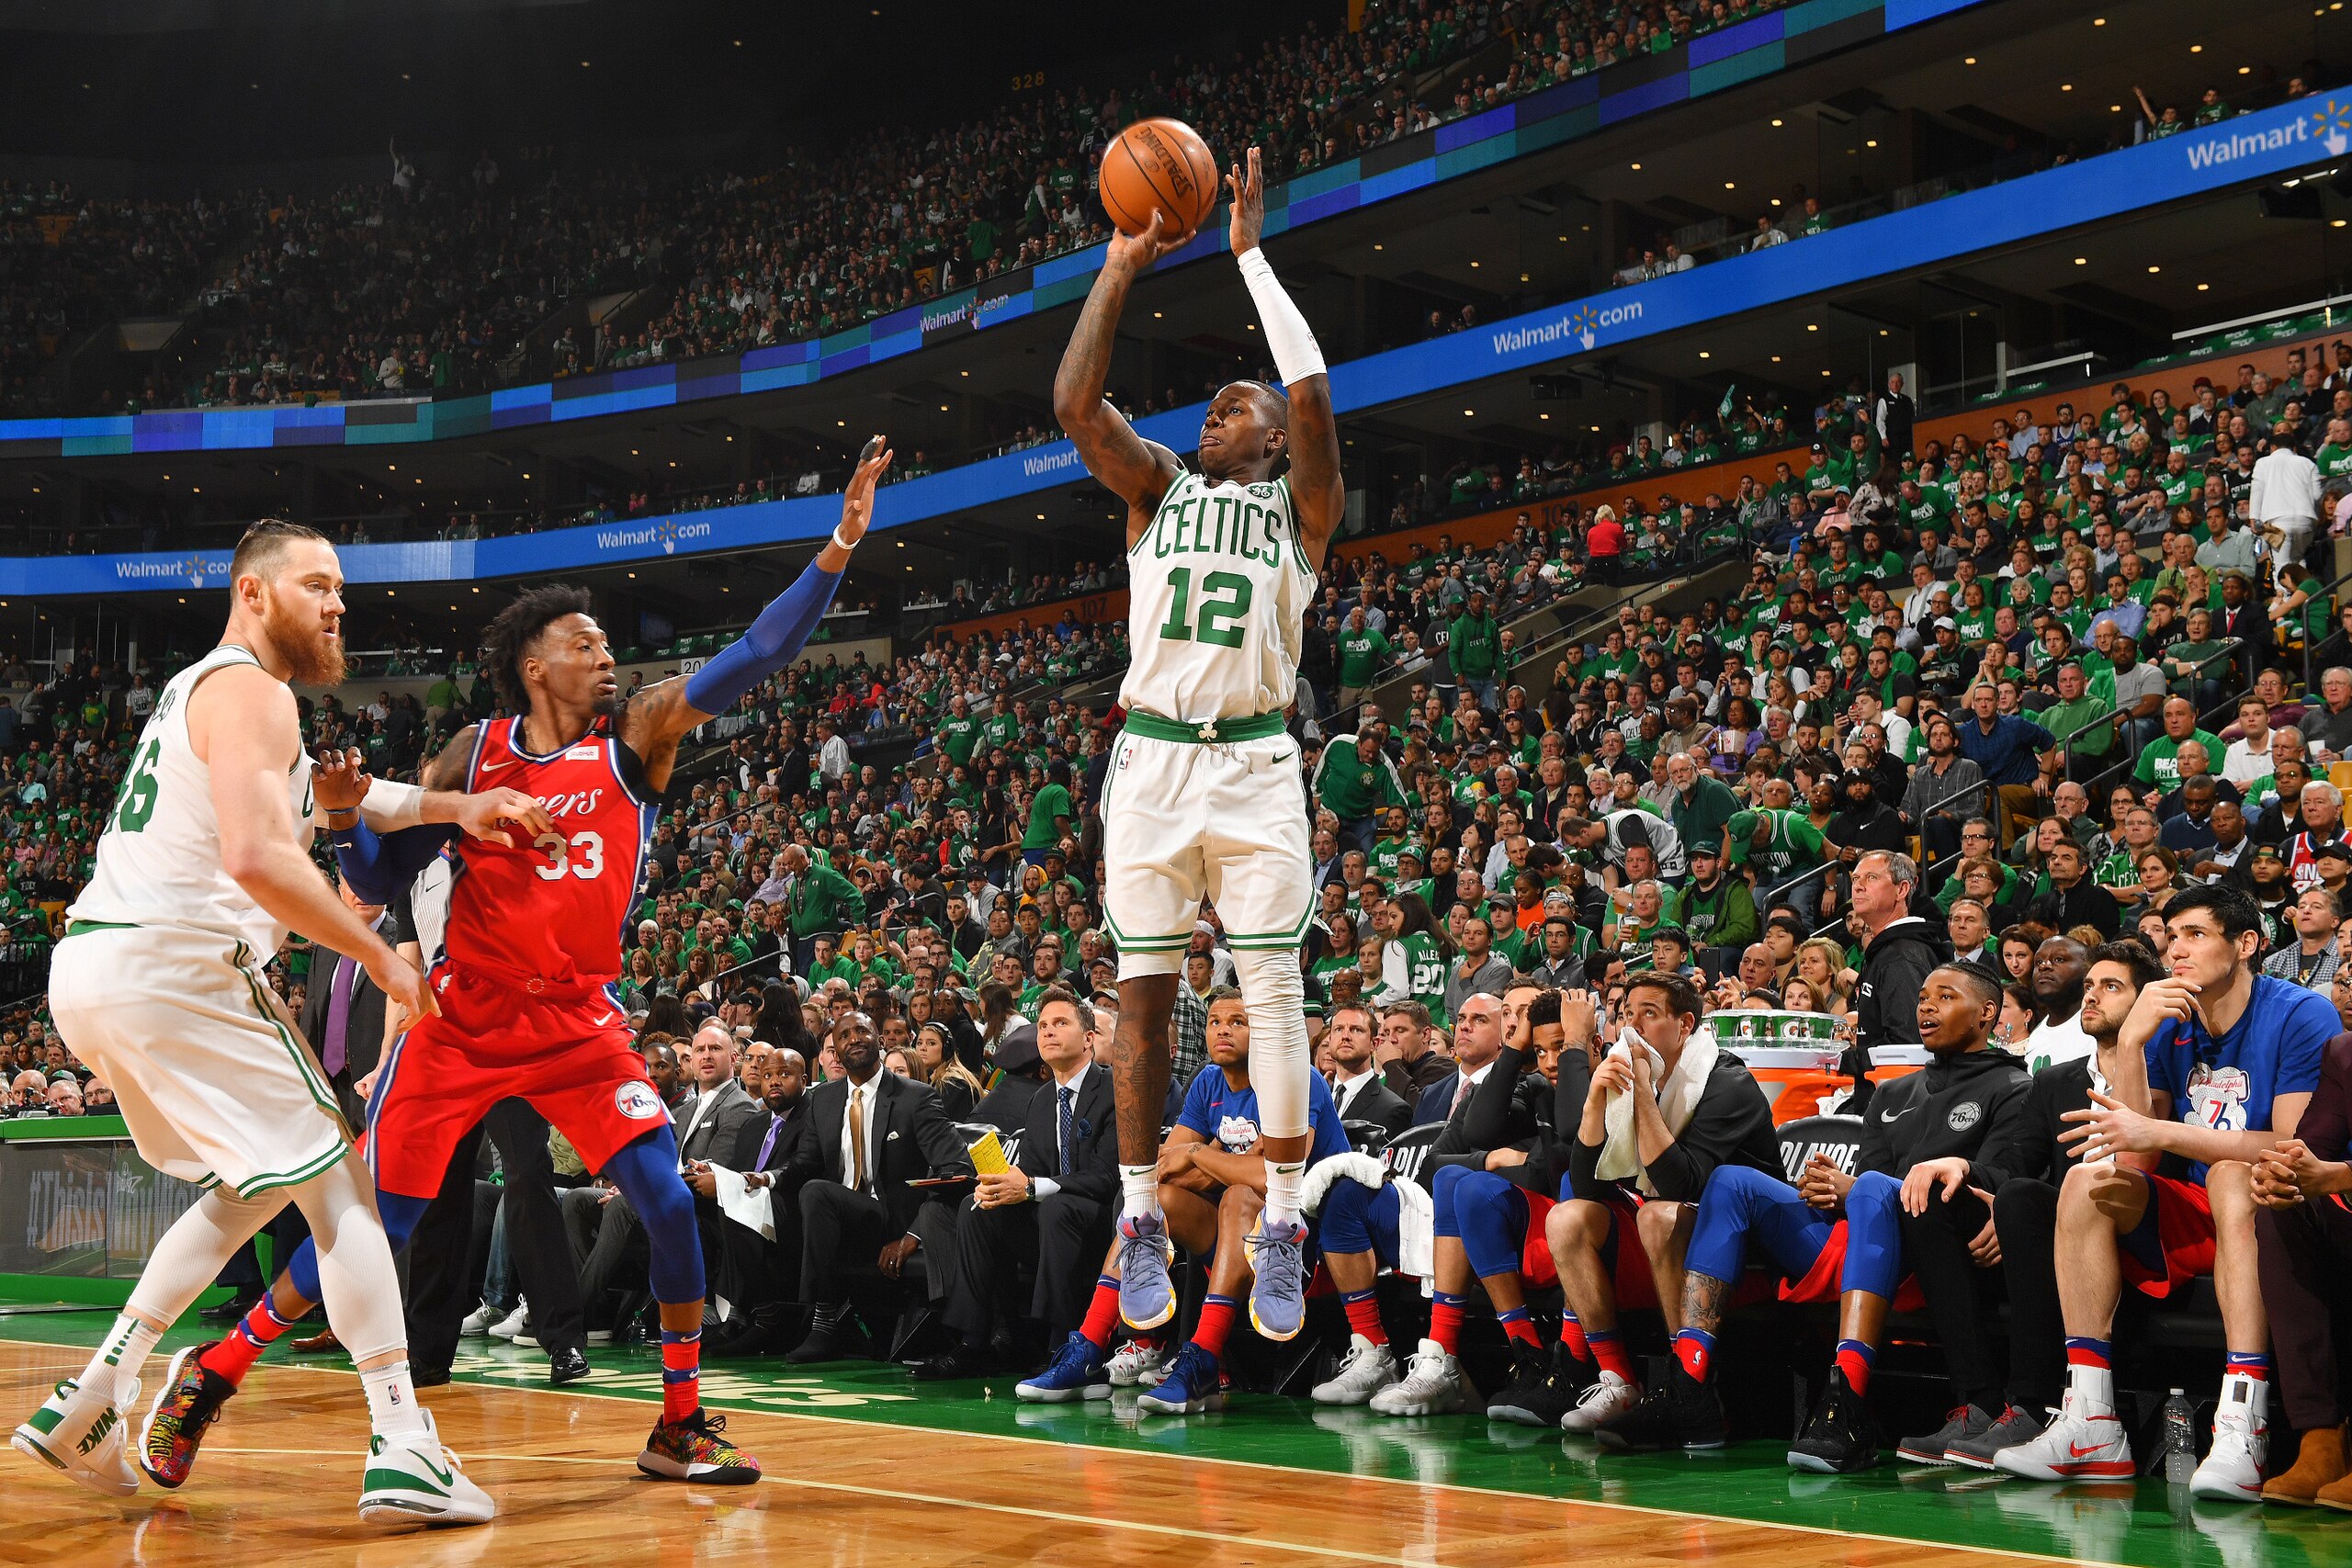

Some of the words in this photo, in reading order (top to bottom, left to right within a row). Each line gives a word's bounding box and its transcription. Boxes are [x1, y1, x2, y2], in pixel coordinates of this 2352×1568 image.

[1012, 72, 1045, 91] 328
[2187, 116, 2309, 171] Walmart
[1135, 126, 1193, 198] SPALDING
[920, 303, 967, 333] Walmart
[1493, 316, 1570, 355] Walmart
[1599, 300, 1644, 327] com
[1023, 446, 1080, 477] Walmart
[596, 525, 657, 549] Walmart
[678, 523, 711, 539] com
[1155, 497, 1282, 569] CELTICS
[116, 560, 184, 579] Walmart
[1080, 596, 1108, 621] 107
[1159, 567, 1253, 649] 12
[2154, 758, 2178, 769] BEA
[533, 830, 604, 880] 33
[1410, 964, 1446, 995] 20
[1950, 1111, 1975, 1123] 76ers
[1780, 1142, 1860, 1183] PLAYOF
[76, 1407, 119, 1457] NIKE
